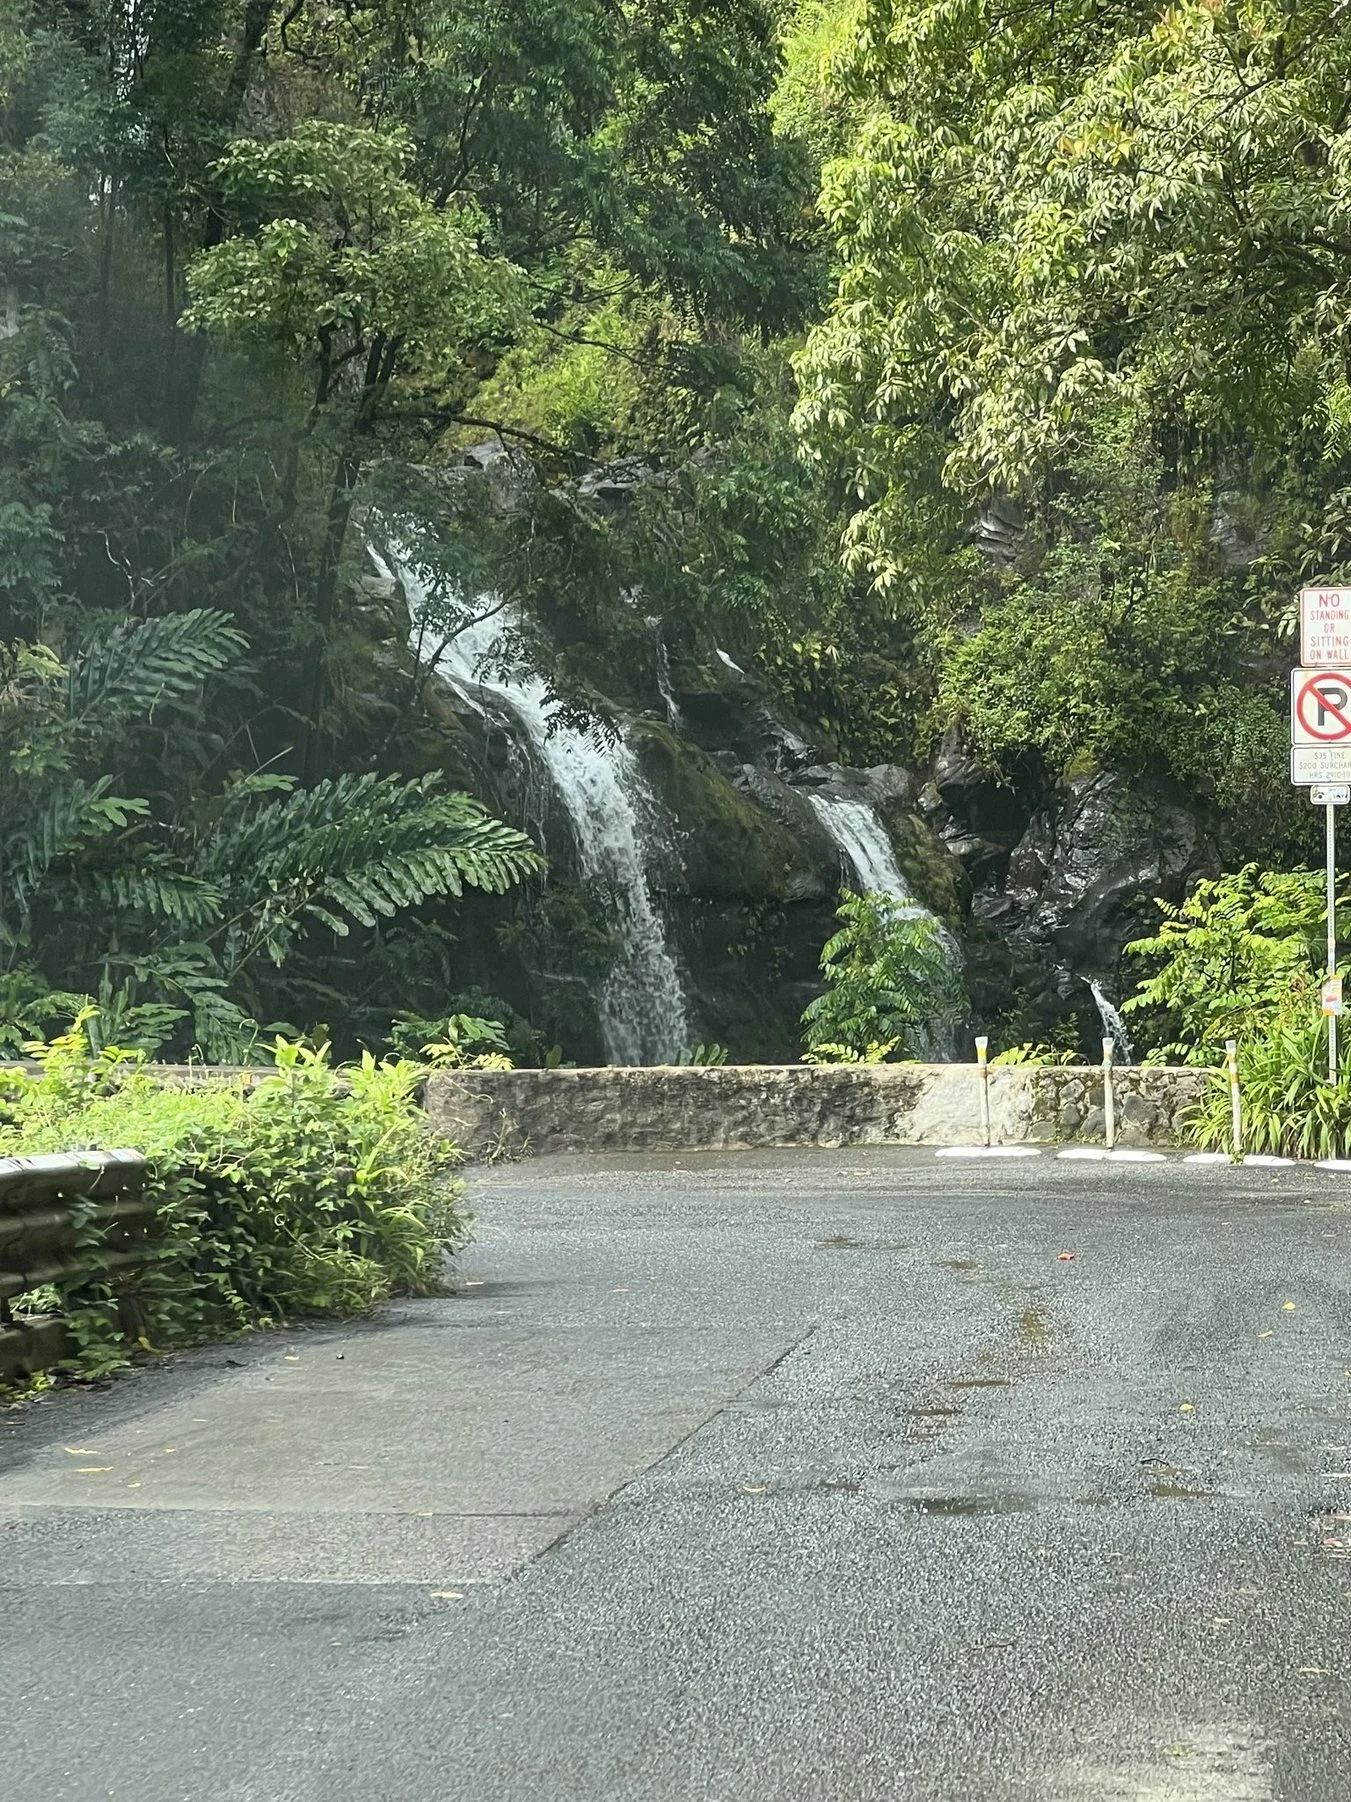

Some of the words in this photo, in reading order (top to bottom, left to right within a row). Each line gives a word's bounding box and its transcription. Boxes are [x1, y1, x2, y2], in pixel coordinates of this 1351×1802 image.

[1319, 593, 1340, 607] NO
[1310, 609, 1349, 621] STANDING
[1323, 622, 1335, 634] OR
[1310, 636, 1349, 647] SITTING
[1310, 649, 1322, 660] ON
[1326, 649, 1349, 660] WALL
[1317, 687, 1348, 726] P
